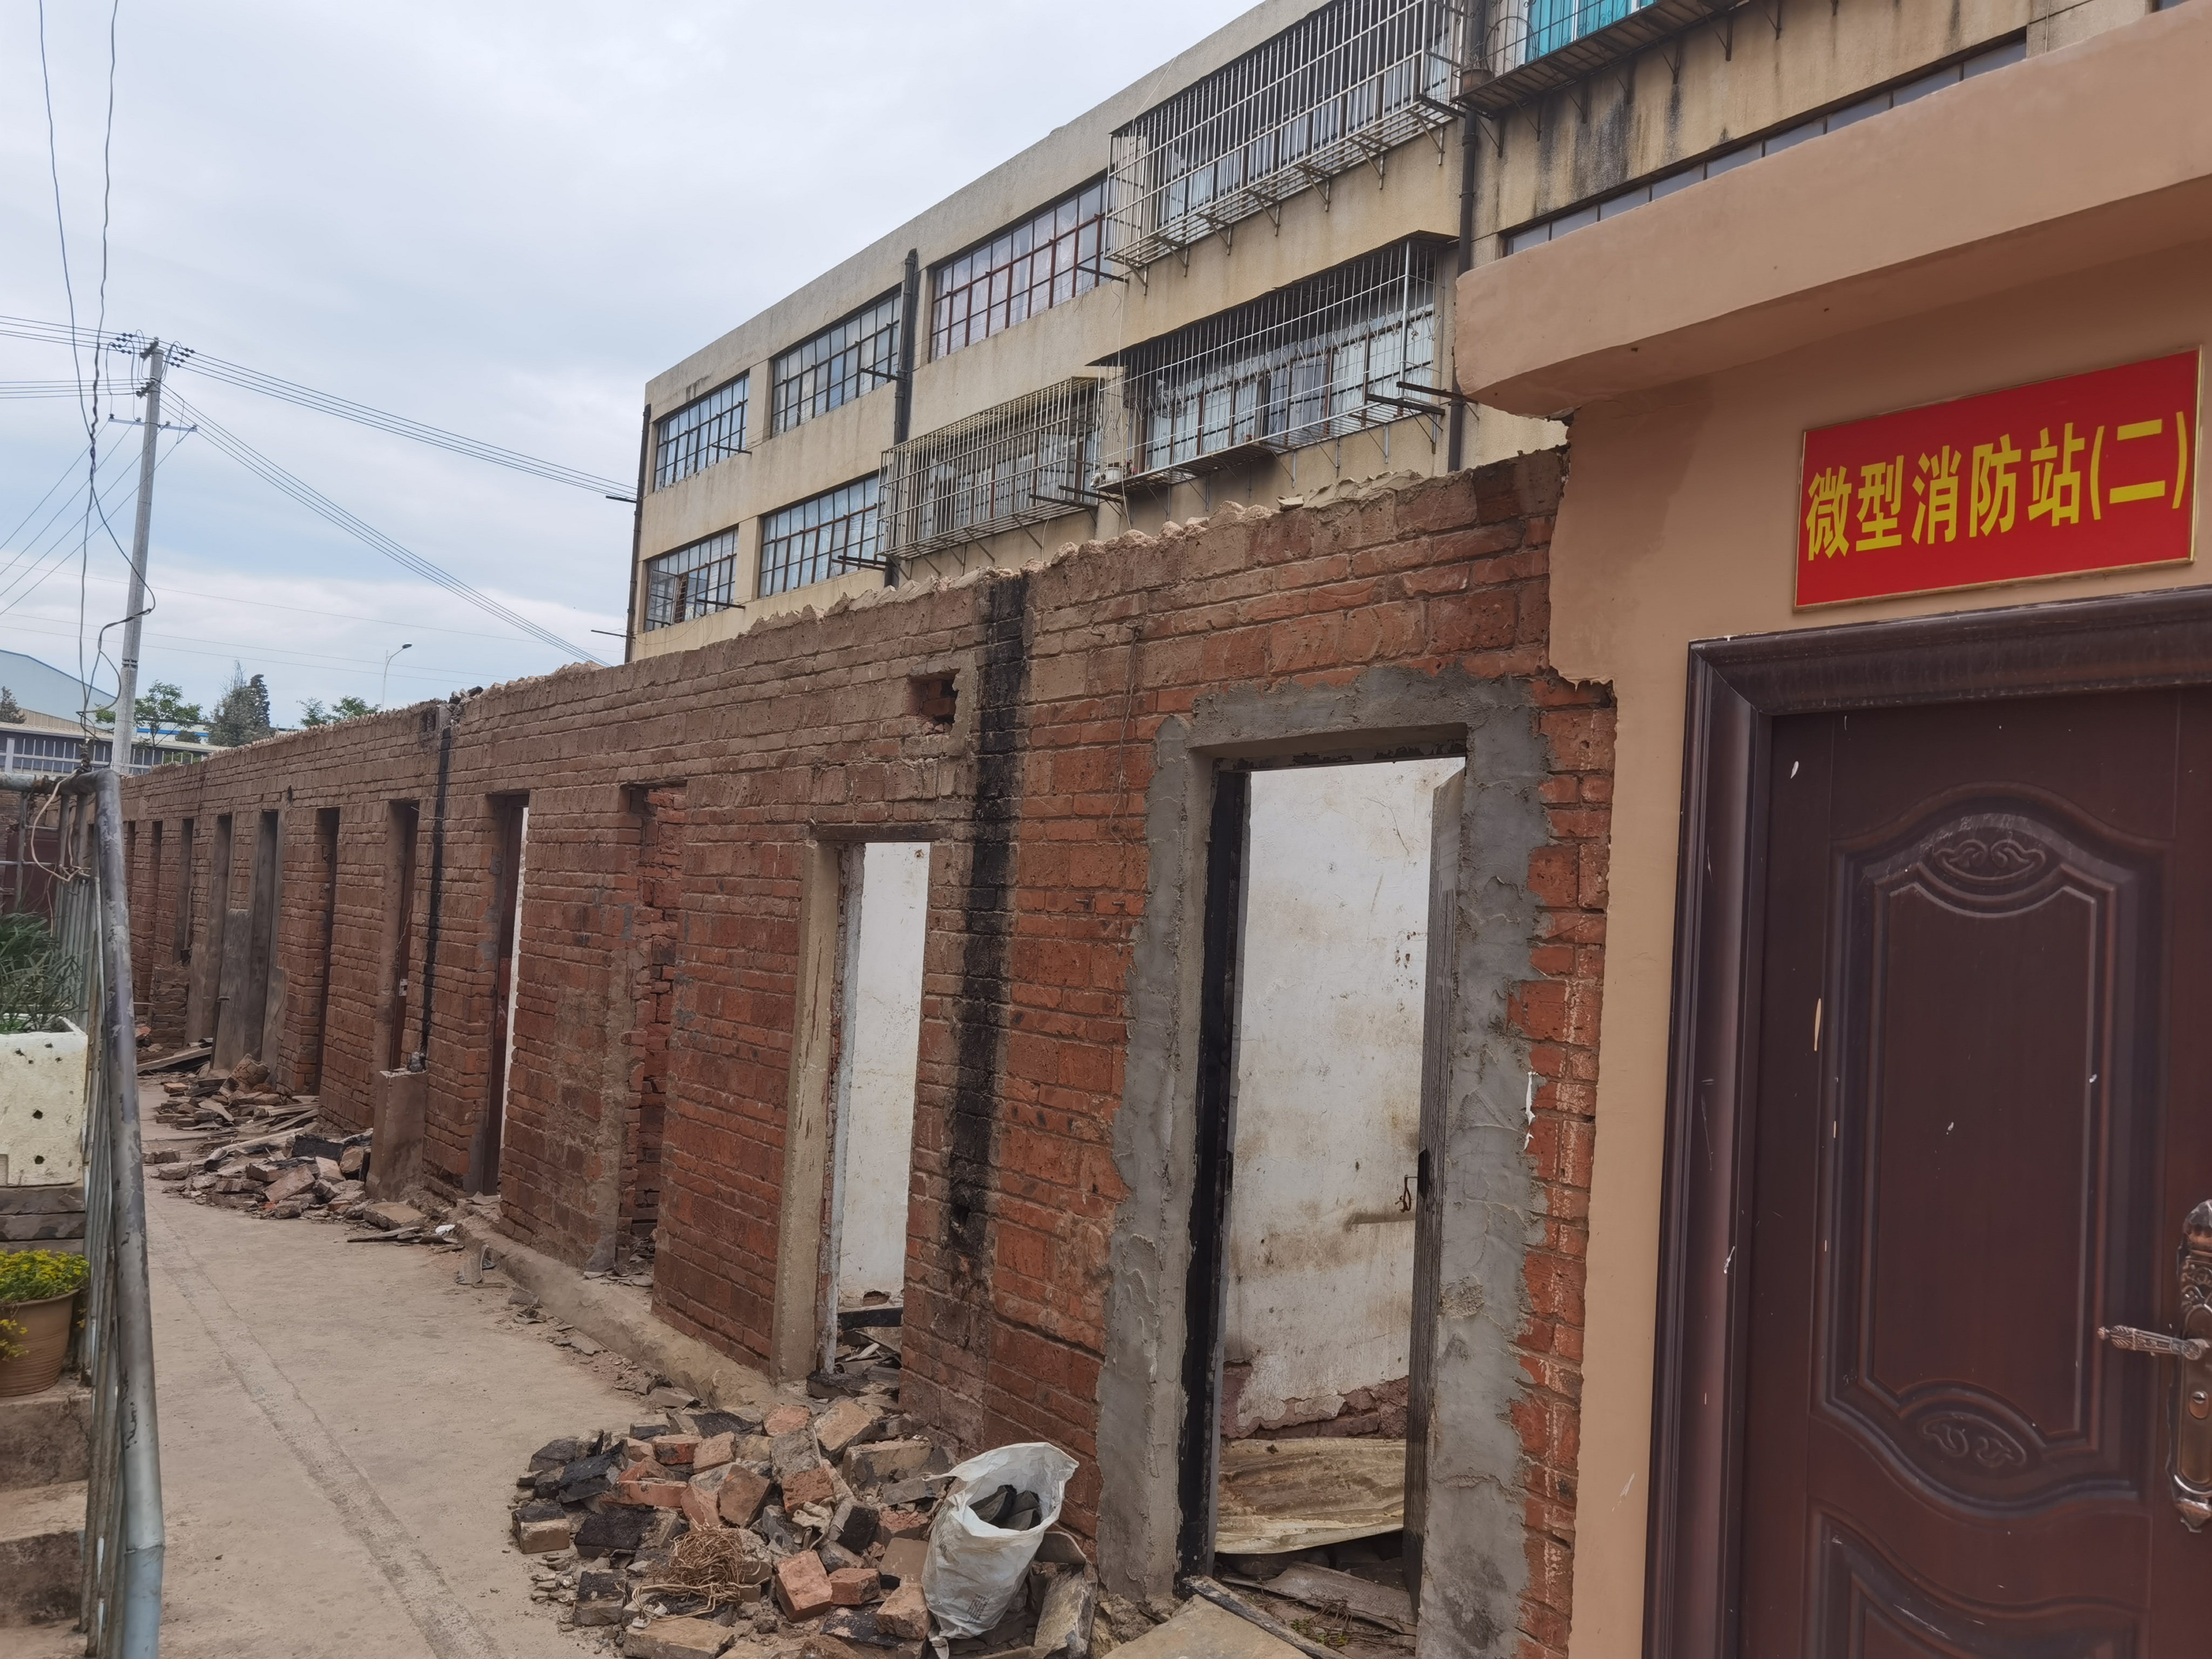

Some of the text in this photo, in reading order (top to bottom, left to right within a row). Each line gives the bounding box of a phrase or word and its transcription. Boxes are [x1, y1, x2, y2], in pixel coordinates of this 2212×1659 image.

[1805, 411, 2188, 561] 微型消防站(二)
